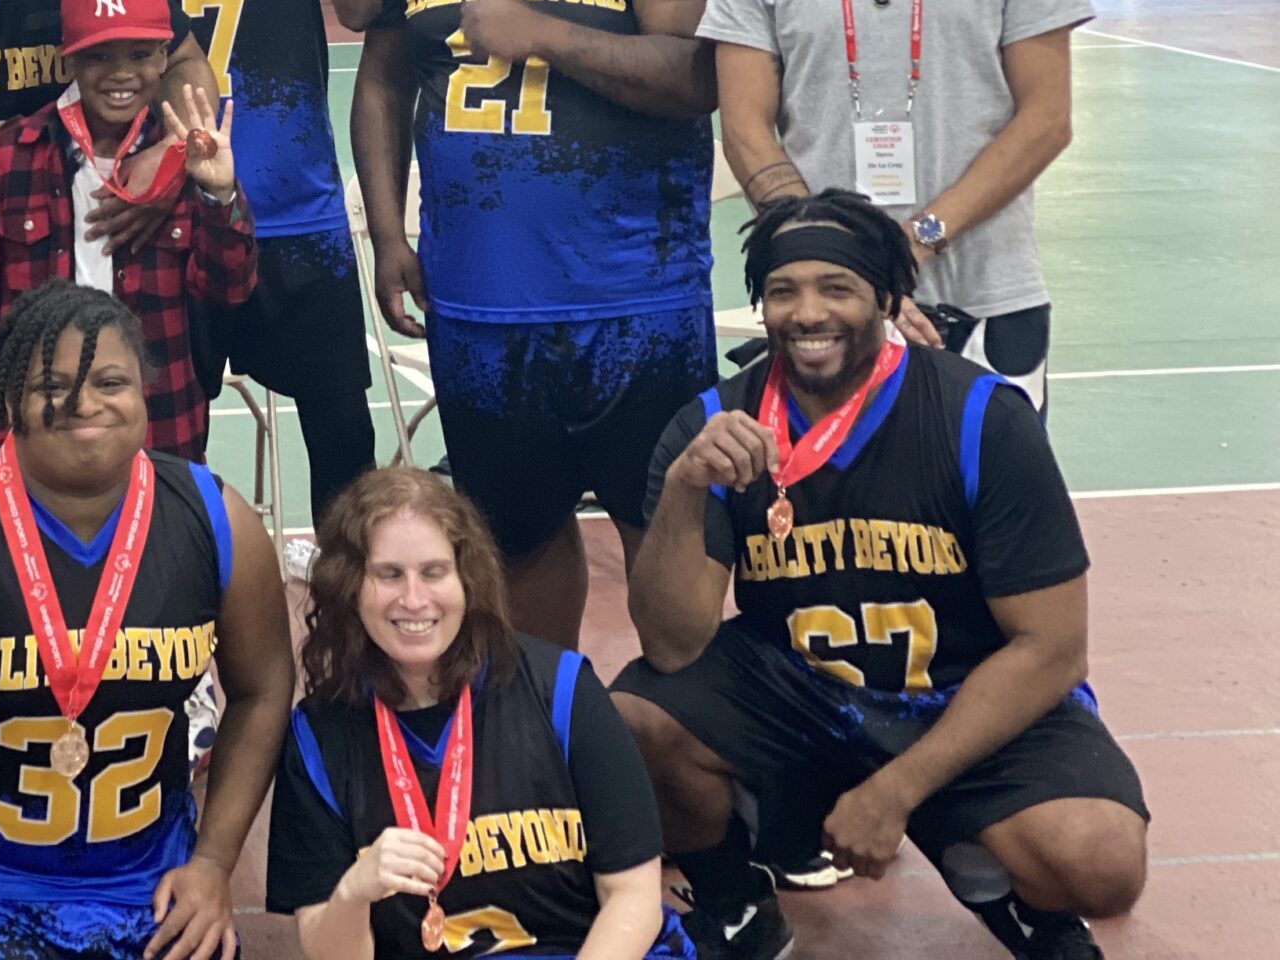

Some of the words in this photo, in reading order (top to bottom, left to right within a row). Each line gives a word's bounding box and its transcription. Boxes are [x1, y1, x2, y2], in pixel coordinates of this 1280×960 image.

[4, 44, 72, 90] BEYO
[445, 28, 551, 135] 21
[850, 518, 968, 574] BEYOND
[101, 620, 218, 681] BEYON
[786, 597, 938, 689] 67
[459, 809, 587, 877] BEYOND
